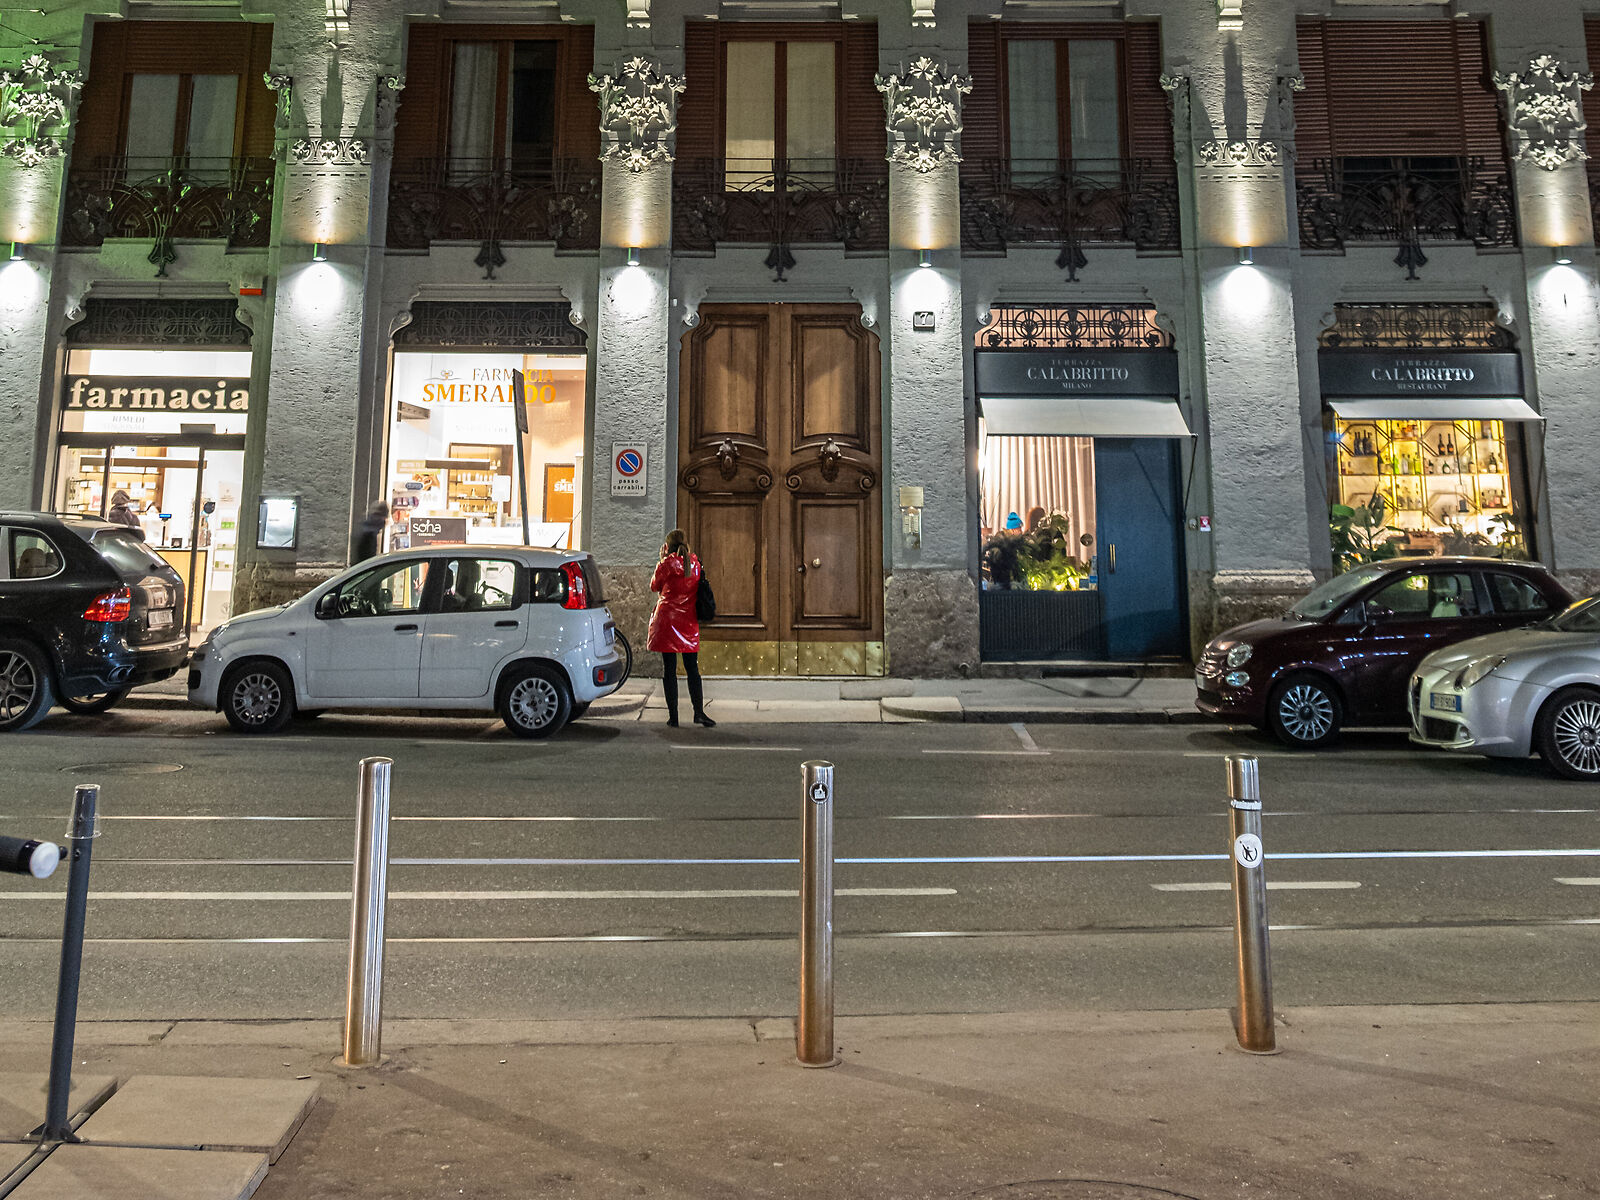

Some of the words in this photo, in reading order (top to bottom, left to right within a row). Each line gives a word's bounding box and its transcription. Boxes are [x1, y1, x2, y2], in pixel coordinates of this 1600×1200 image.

[920, 312, 928, 325] 7
[1027, 367, 1129, 380] CALABRITTO
[1371, 368, 1475, 381] CALABRITTO
[68, 378, 249, 410] farmacia
